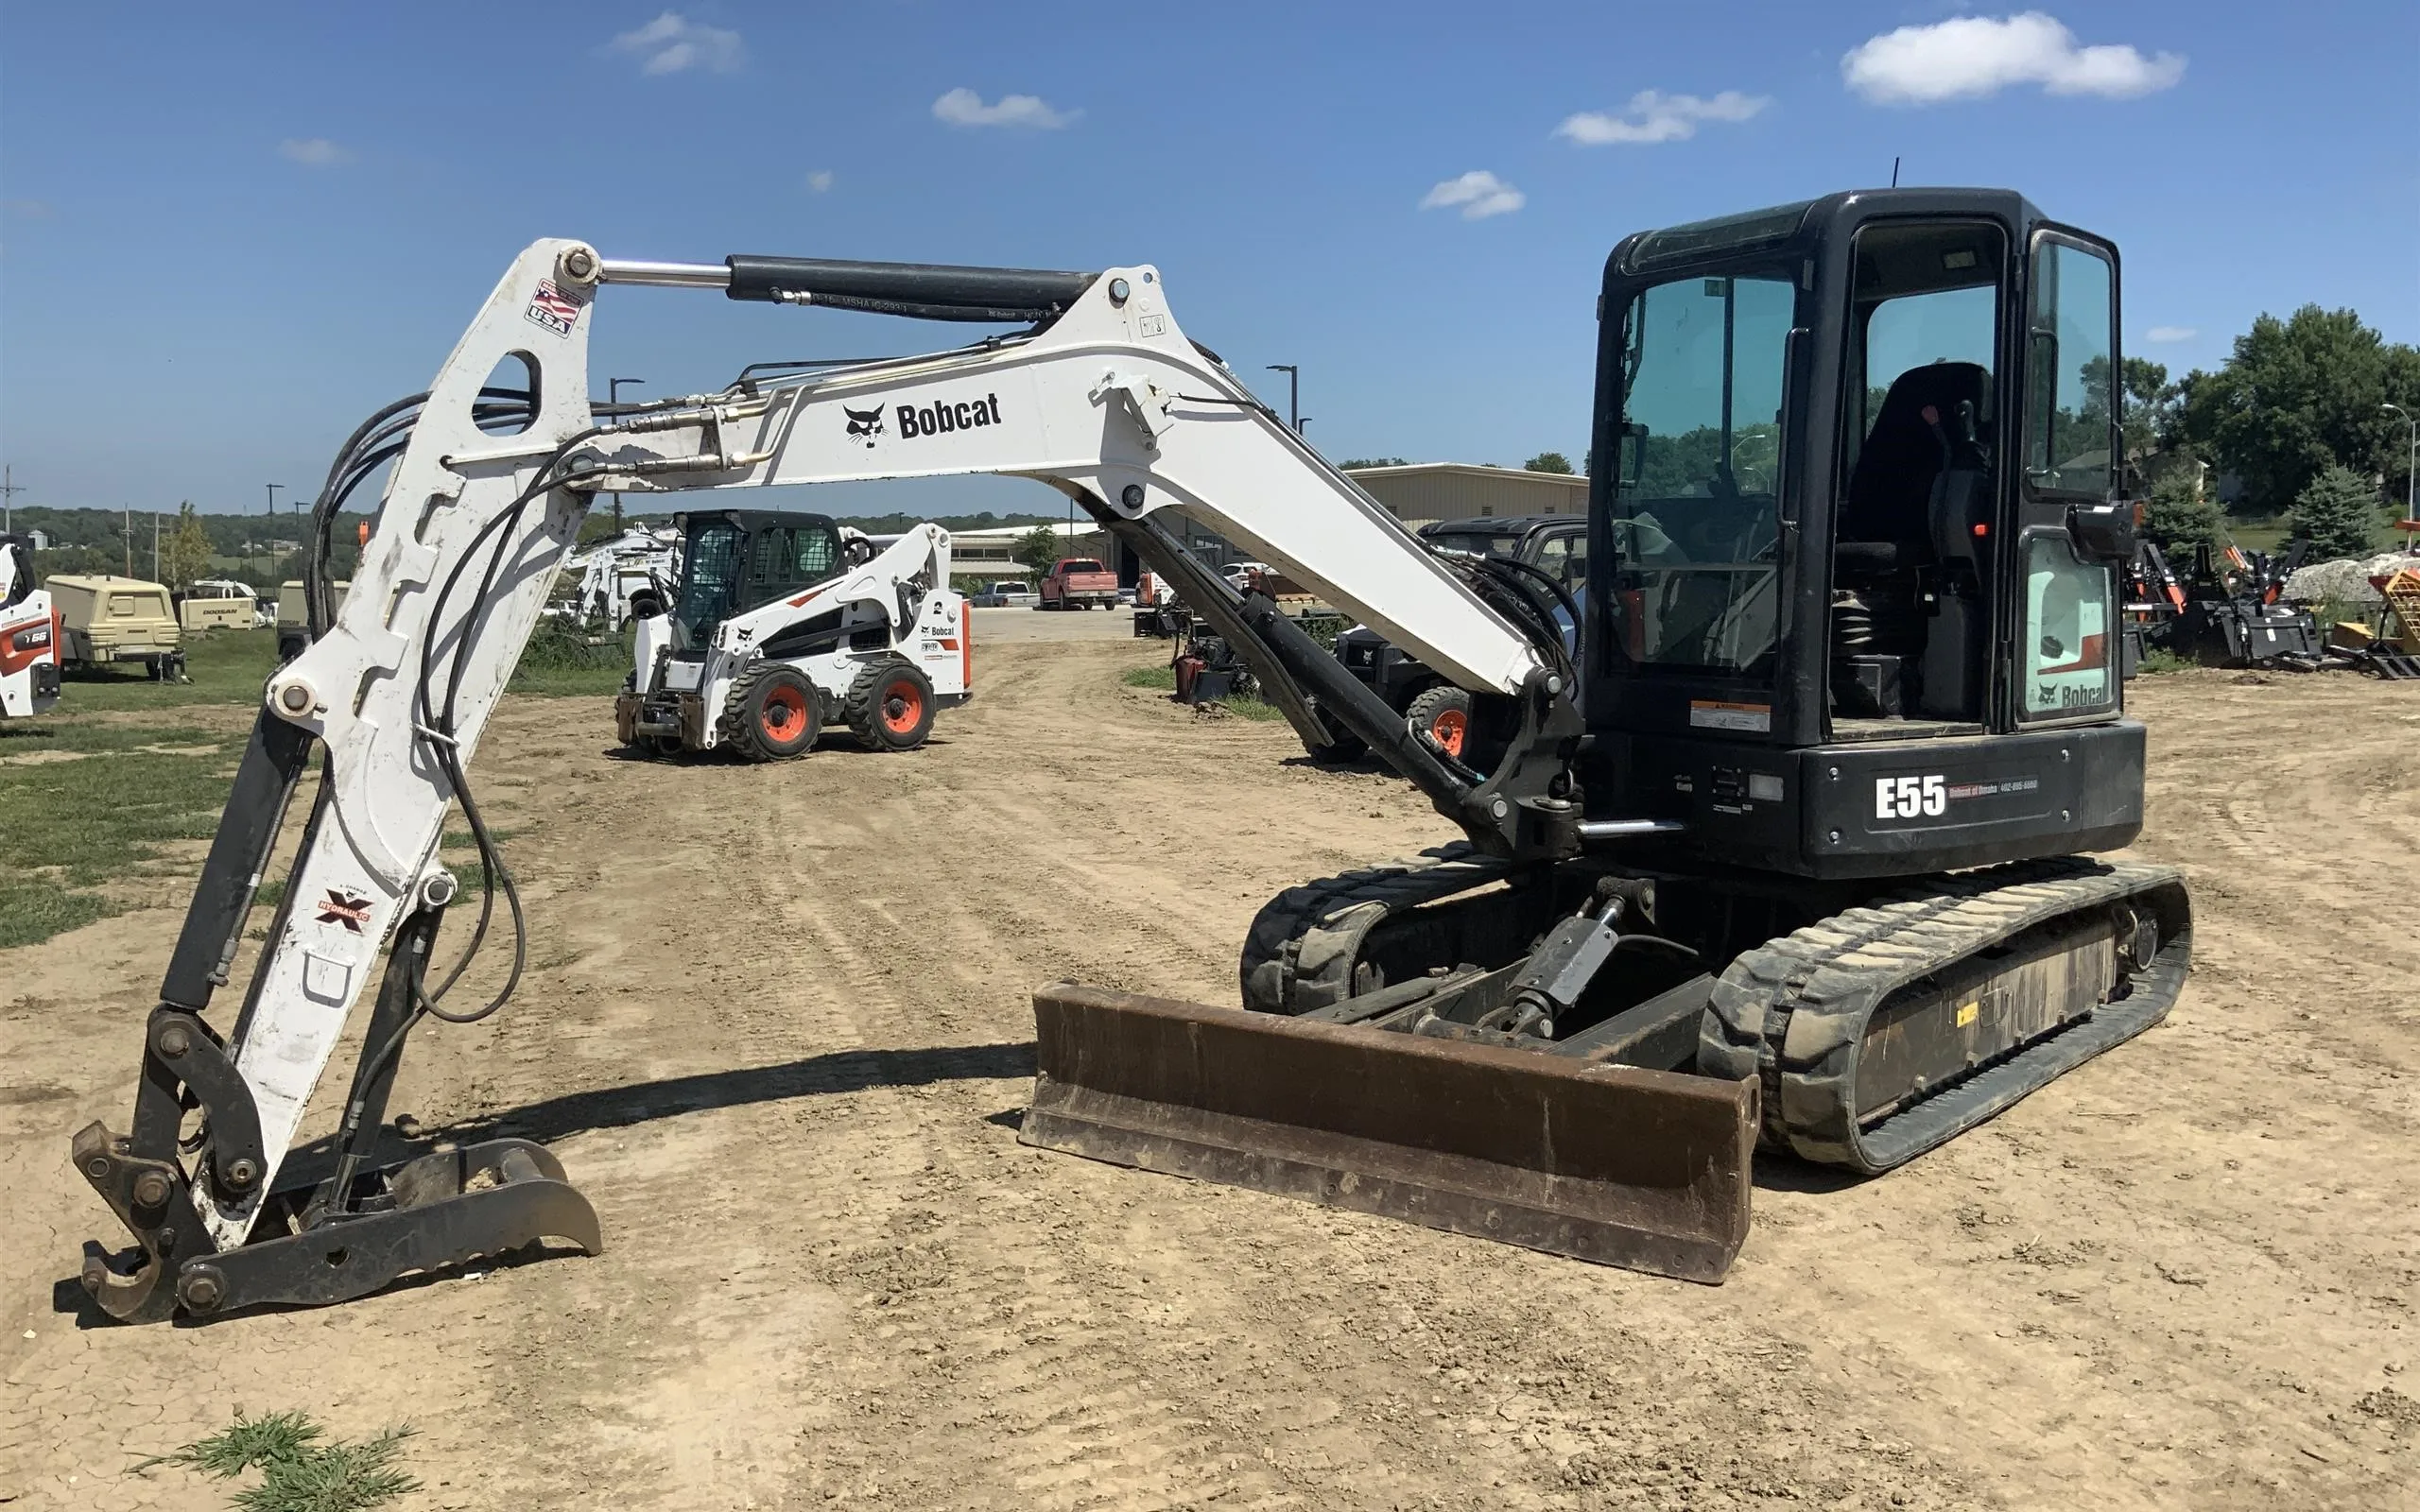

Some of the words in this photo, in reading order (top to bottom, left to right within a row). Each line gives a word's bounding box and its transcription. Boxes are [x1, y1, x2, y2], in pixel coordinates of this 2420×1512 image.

[528, 306, 567, 333] USA
[896, 393, 1002, 439] Bobcat
[931, 627, 955, 636] Bobcat
[2062, 684, 2103, 707] Bobca
[1876, 775, 1945, 819] E55
[320, 901, 371, 922] HYDRAULIC
